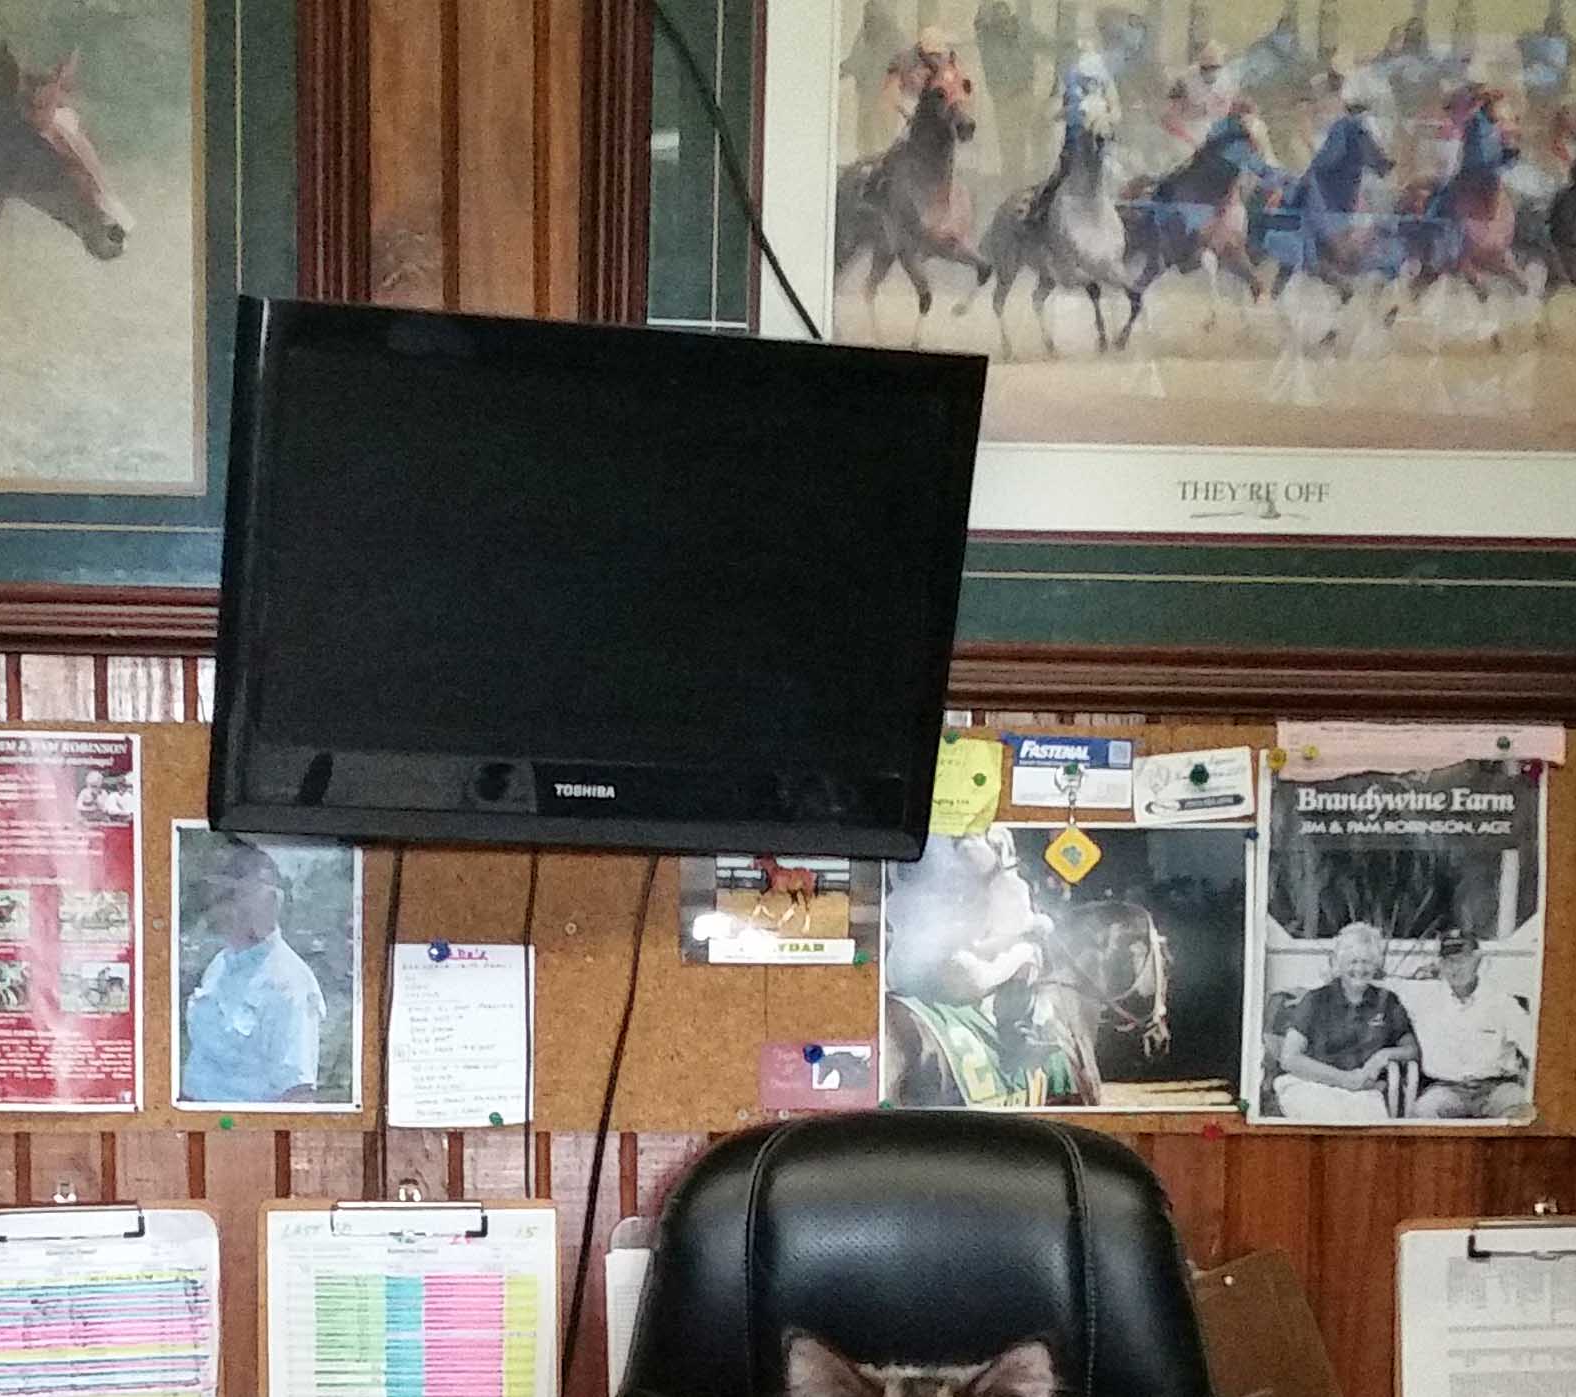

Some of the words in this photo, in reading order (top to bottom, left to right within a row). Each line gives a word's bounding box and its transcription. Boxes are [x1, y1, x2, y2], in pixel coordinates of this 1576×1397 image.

[1177, 480, 1278, 502] THEY'RE
[1285, 482, 1331, 503] OFF
[61, 742, 127, 754] ROBINSON
[1019, 740, 1090, 760] FASTENAL
[554, 784, 615, 798] TOSHIBA
[1297, 784, 1446, 820] Brandywine
[1450, 788, 1515, 812] Farm
[1300, 821, 1326, 834] JIM
[1328, 821, 1344, 834] &
[1347, 821, 1382, 834] PAM
